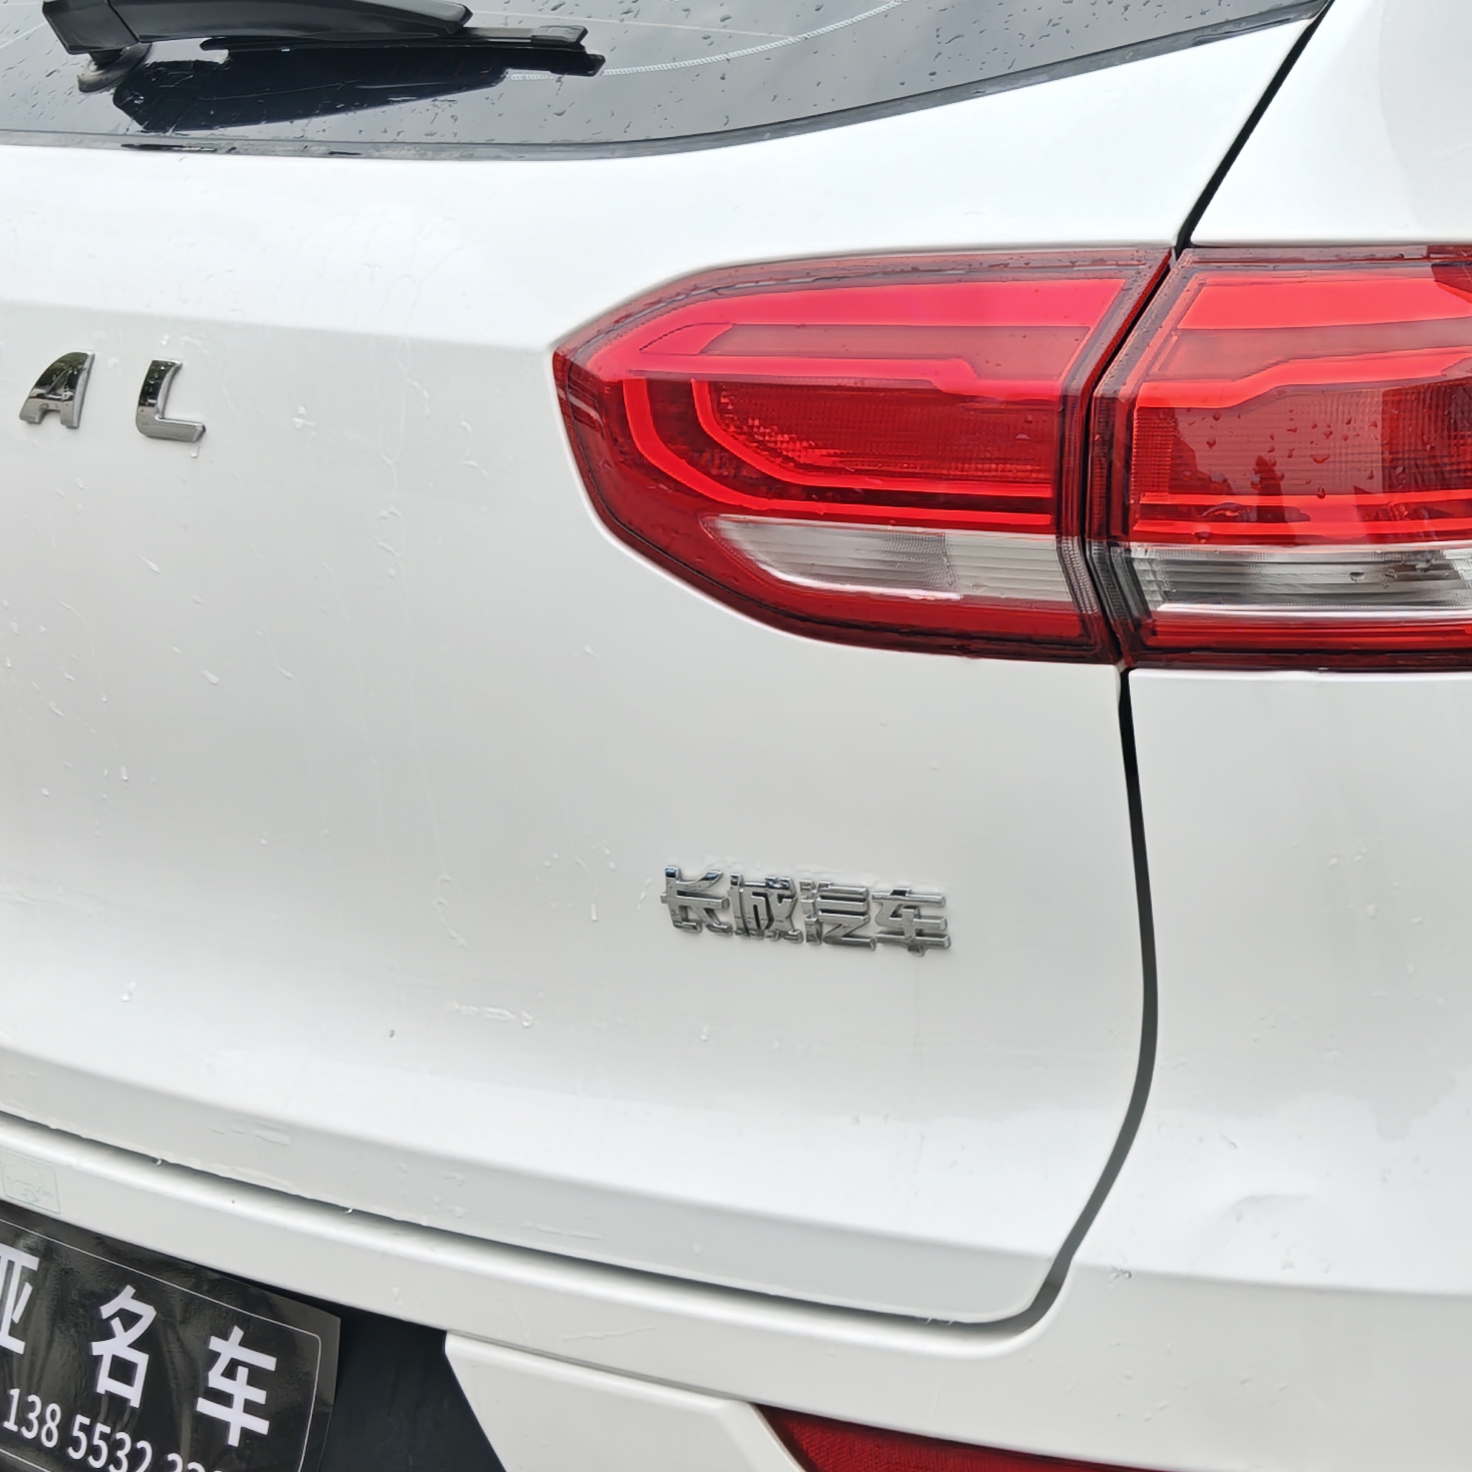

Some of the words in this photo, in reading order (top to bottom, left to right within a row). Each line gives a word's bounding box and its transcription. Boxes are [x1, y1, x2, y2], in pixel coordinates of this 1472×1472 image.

[660, 865, 952, 957] 长城汽车
[3, 1387, 60, 1449] 138
